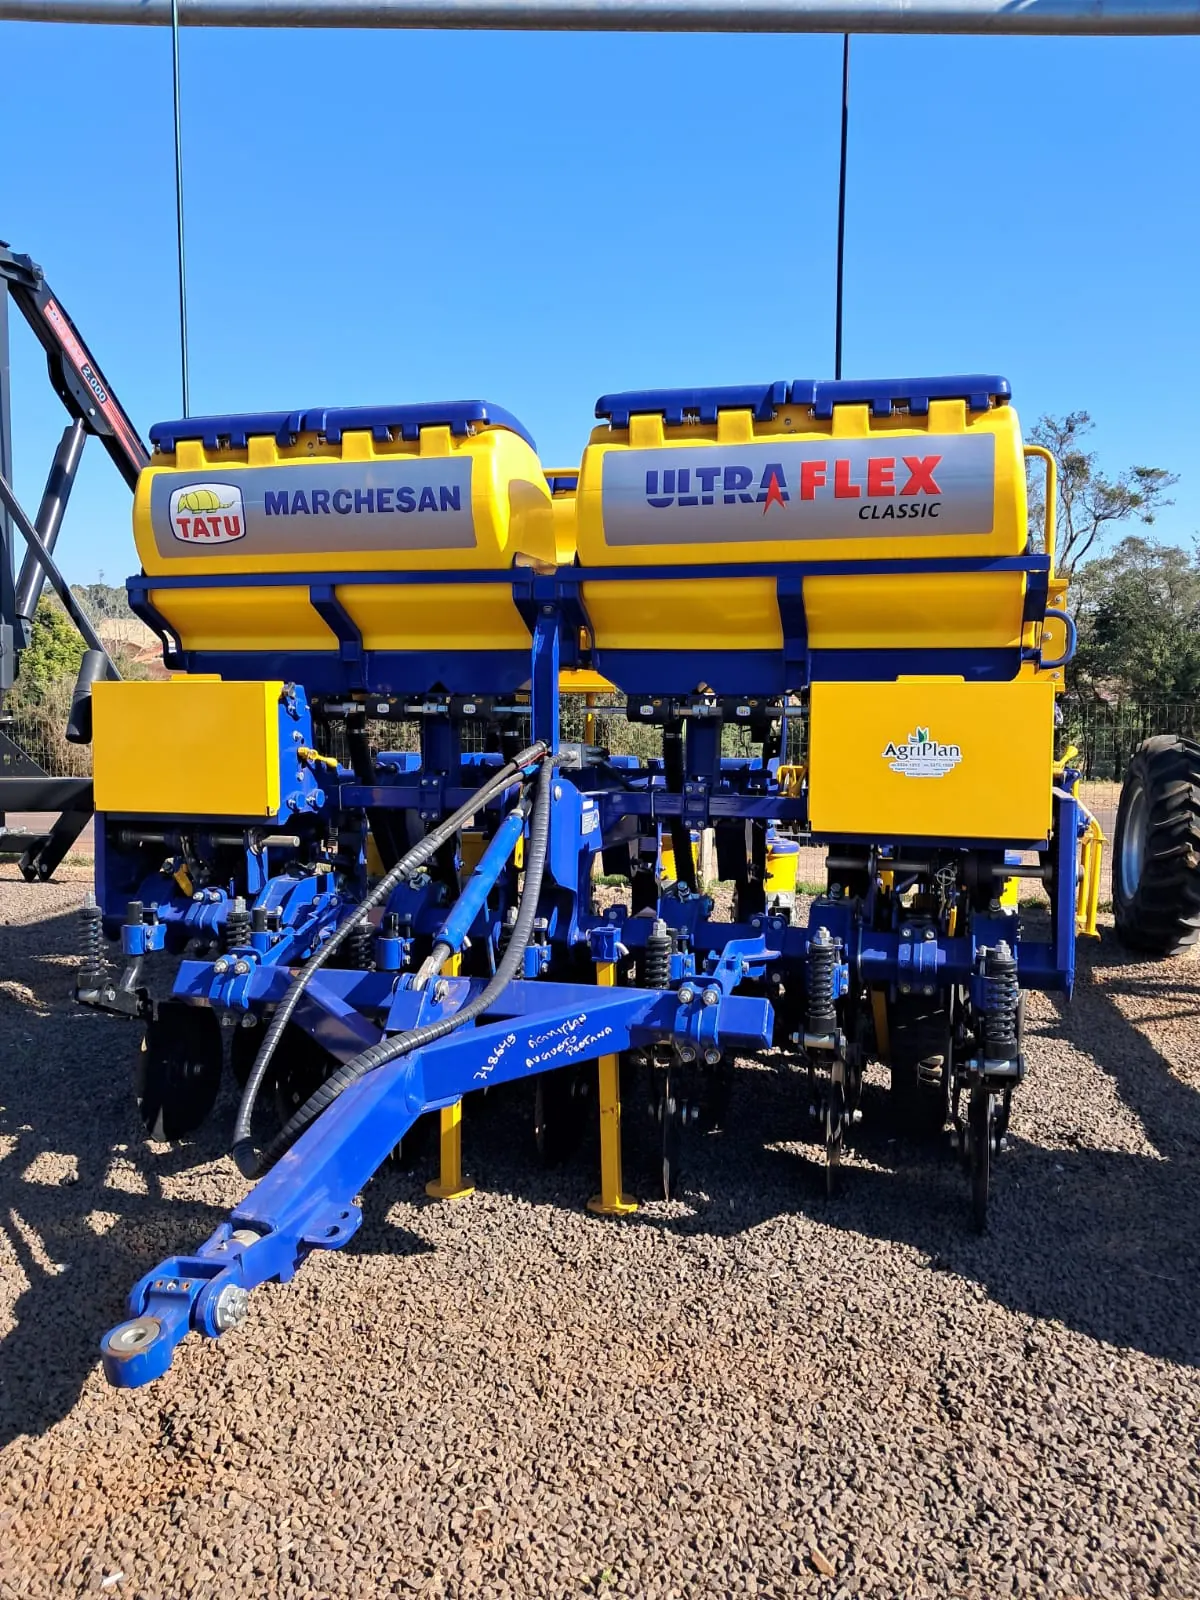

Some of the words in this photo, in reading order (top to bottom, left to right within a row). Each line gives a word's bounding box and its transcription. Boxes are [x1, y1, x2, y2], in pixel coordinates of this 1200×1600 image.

[82, 365, 107, 402] 2.000
[646, 463, 791, 516] ULTRA
[800, 455, 943, 500] FLEX
[264, 485, 461, 515] MARCHESAN
[858, 502, 942, 520] CLASSIC
[176, 515, 241, 538] TATU
[884, 742, 960, 761] AgriPlan
